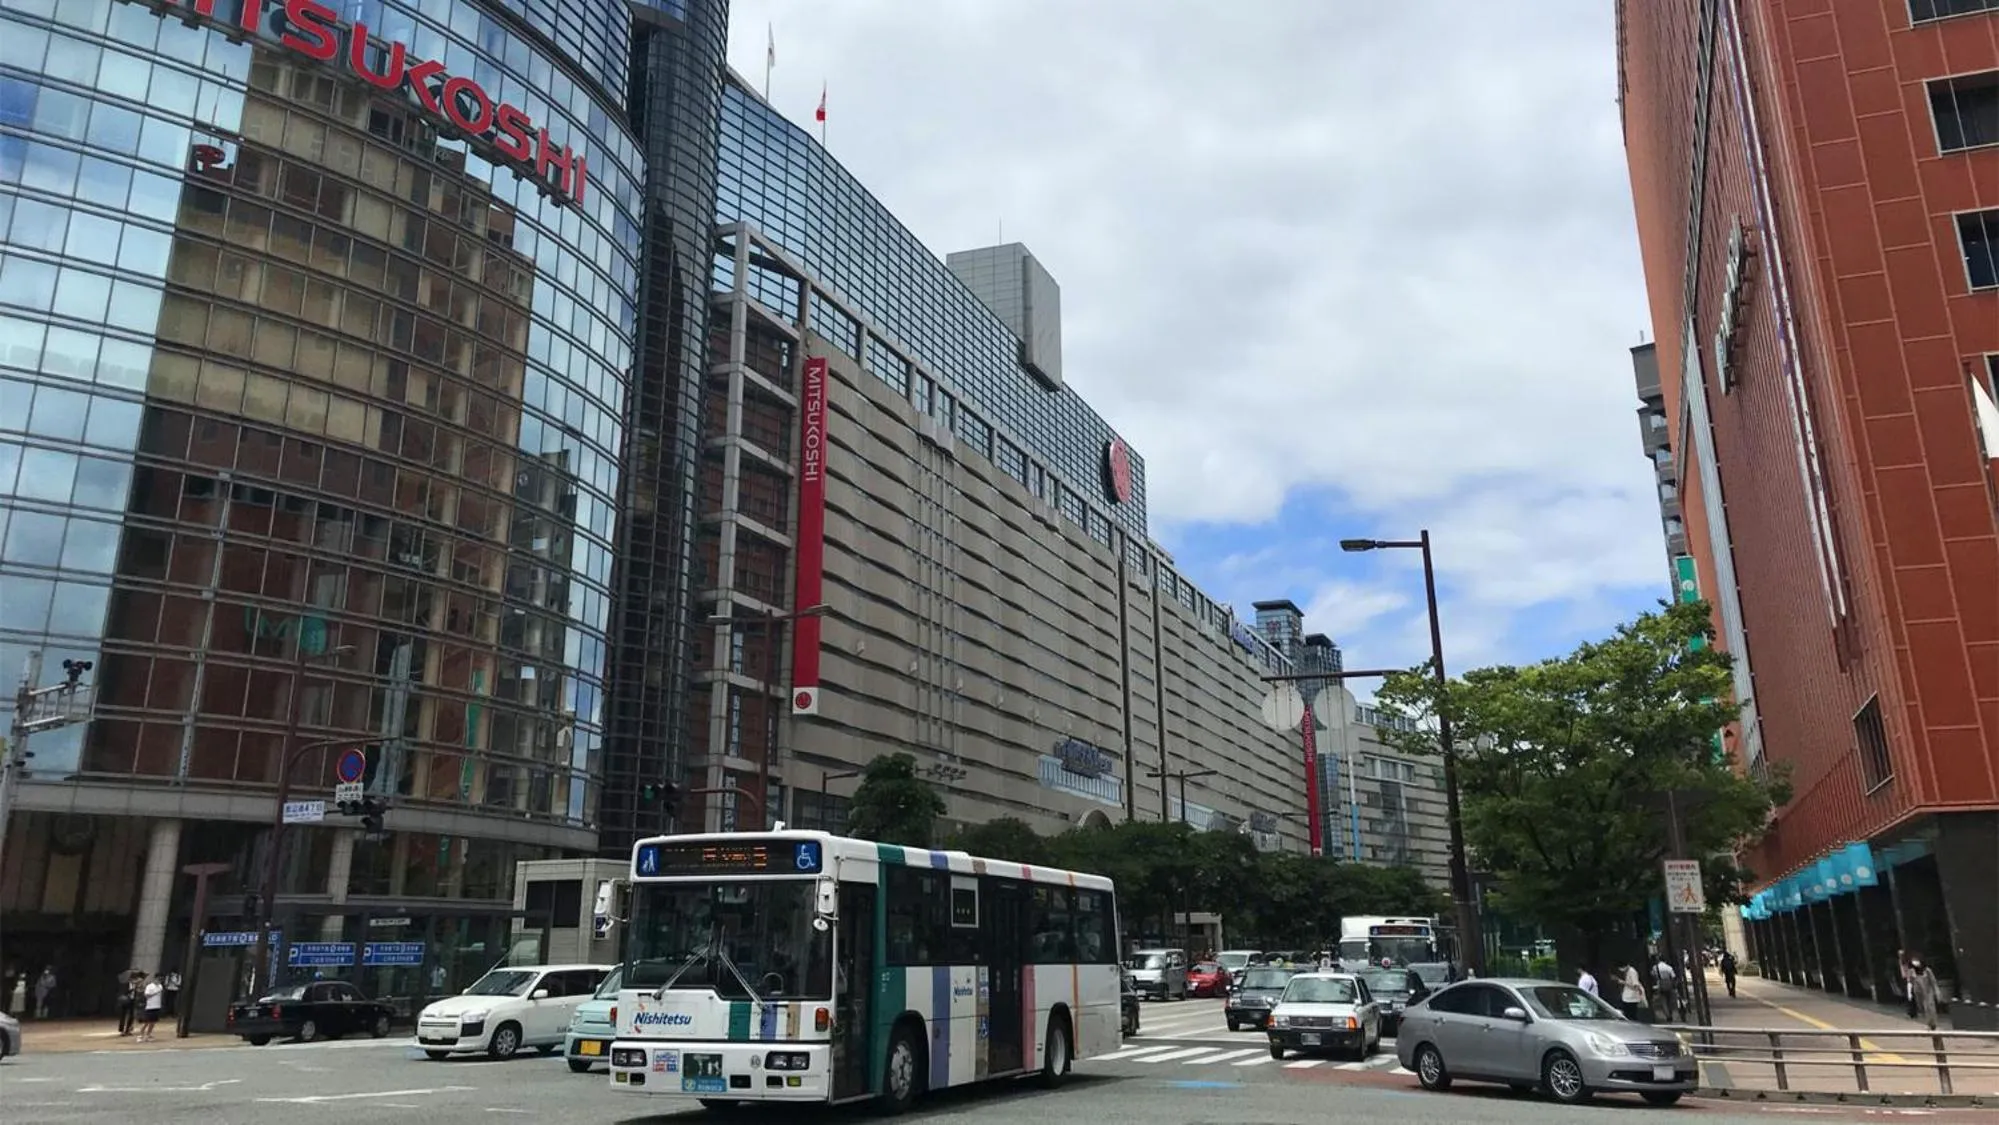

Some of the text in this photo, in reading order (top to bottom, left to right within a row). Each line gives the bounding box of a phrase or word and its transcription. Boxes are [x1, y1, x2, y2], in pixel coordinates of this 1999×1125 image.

[165, 0, 588, 207] SUKOSHI
[805, 366, 821, 481] MITSUKOSHI
[634, 1012, 692, 1026] Nishitetsu
